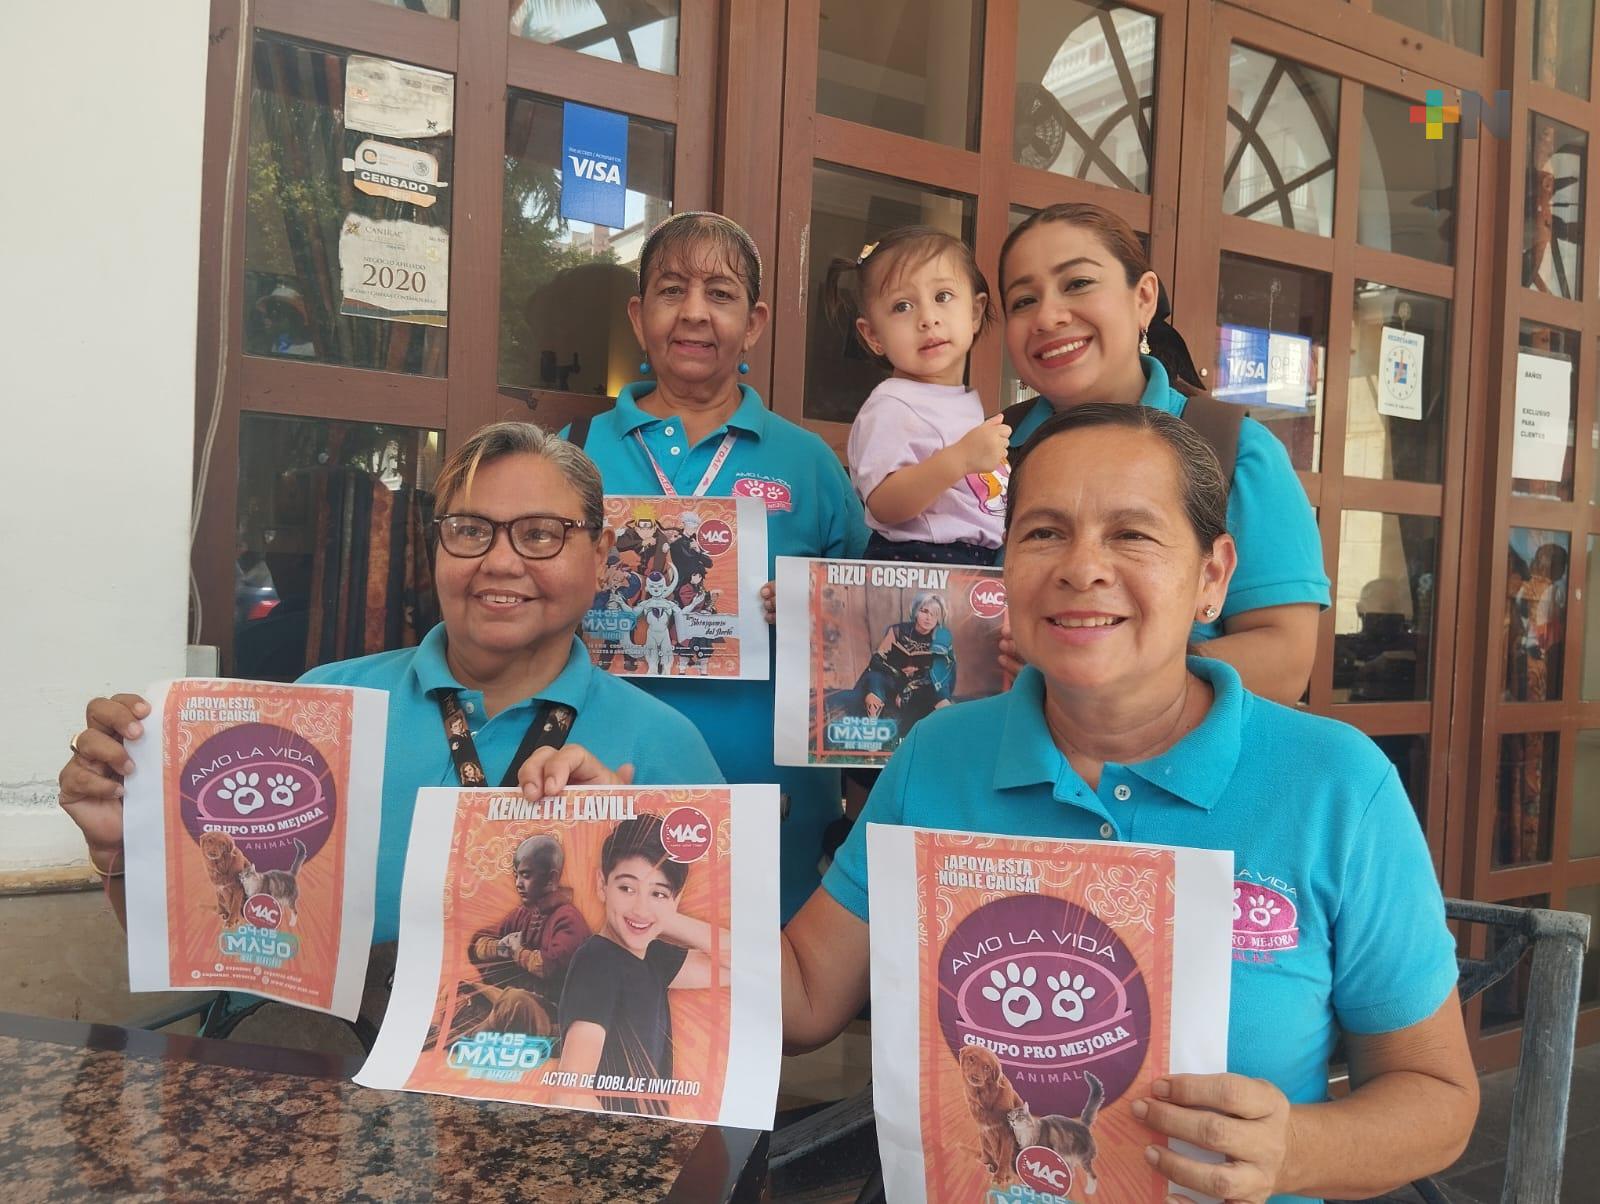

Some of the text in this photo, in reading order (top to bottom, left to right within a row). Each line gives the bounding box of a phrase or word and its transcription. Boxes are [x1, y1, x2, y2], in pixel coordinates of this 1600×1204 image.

[568, 155, 621, 185] VISA
[361, 171, 429, 193] CENSADO
[362, 264, 426, 293] 2020
[1226, 358, 1266, 380] VISA
[1524, 371, 1542, 380] BAÑOS
[1522, 408, 1551, 418] EXCLUSIVO
[700, 530, 729, 543] MAC
[827, 564, 950, 589] RIZU COSPLAY
[974, 590, 1005, 605] MAC
[582, 618, 631, 631] MAYO
[186, 696, 255, 710] ¡APOYA ESTA
[181, 709, 260, 723] NOBLE CAUSA!
[833, 726, 890, 741] MAYO
[191, 746, 316, 786] AMO LA VIDA
[487, 795, 638, 821] KENNETH LAVILL
[203, 807, 324, 835] GRUPO PRO MEJORA
[245, 837, 293, 850] ANIMAL
[668, 823, 708, 843] MAC
[944, 854, 1033, 876] ¡APOYA ESTA
[939, 870, 1040, 893] NOBLE CAUSA!
[1257, 871, 1297, 899] VIDA
[249, 900, 279, 924] MAC
[226, 935, 291, 959] MAYO
[1232, 933, 1294, 947] RO MEJORA
[952, 929, 1116, 975] AMO LA VIDA
[963, 1025, 1130, 1059] GRUPO PRO MEJORA
[456, 1045, 540, 1069] MAYO
[540, 1071, 577, 1088] ACTOR
[579, 1074, 596, 1089] DE
[596, 1075, 647, 1093] DOBLAJE
[647, 1078, 700, 1096] INVITADO
[1015, 1069, 1083, 1083] ANIMAL
[1025, 1159, 1068, 1189] MAC
